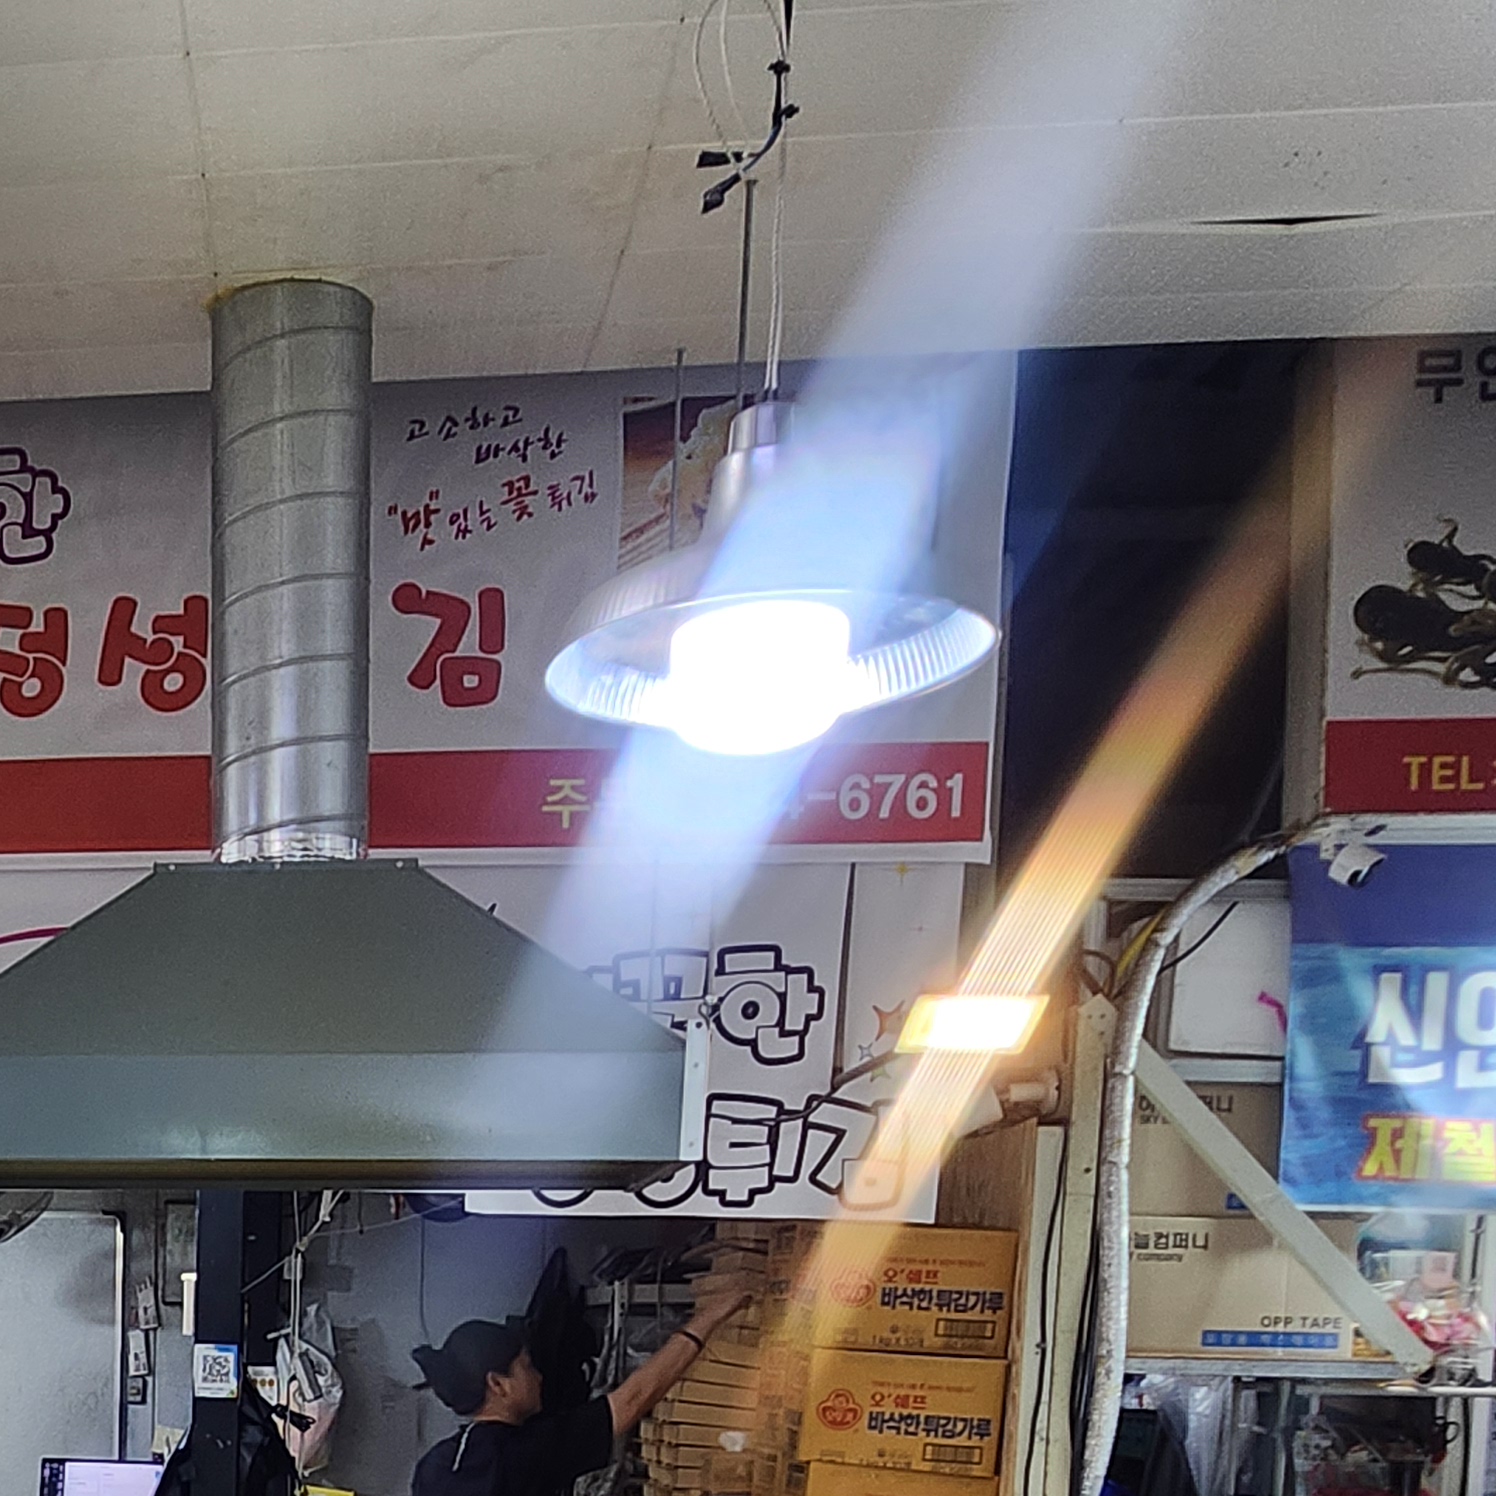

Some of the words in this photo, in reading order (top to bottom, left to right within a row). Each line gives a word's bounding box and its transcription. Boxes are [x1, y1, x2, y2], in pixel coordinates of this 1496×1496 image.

[406, 405, 523, 441] 고소하고
[474, 424, 568, 464] 바삭한
[500, 474, 539, 522] 꽃
[547, 469, 598, 512] 튀김
[585, 944, 825, 1066] 끗한
[1133, 1231, 1210, 1250] 늘컴퍼니
[880, 1285, 935, 1312] 바삭한
[935, 1287, 1006, 1315] 튀김가루
[1260, 1315, 1294, 1329] OPP
[1299, 1316, 1344, 1330] TAPE
[867, 1411, 922, 1437] 바삭한
[922, 1414, 992, 1440] 튀김가루
